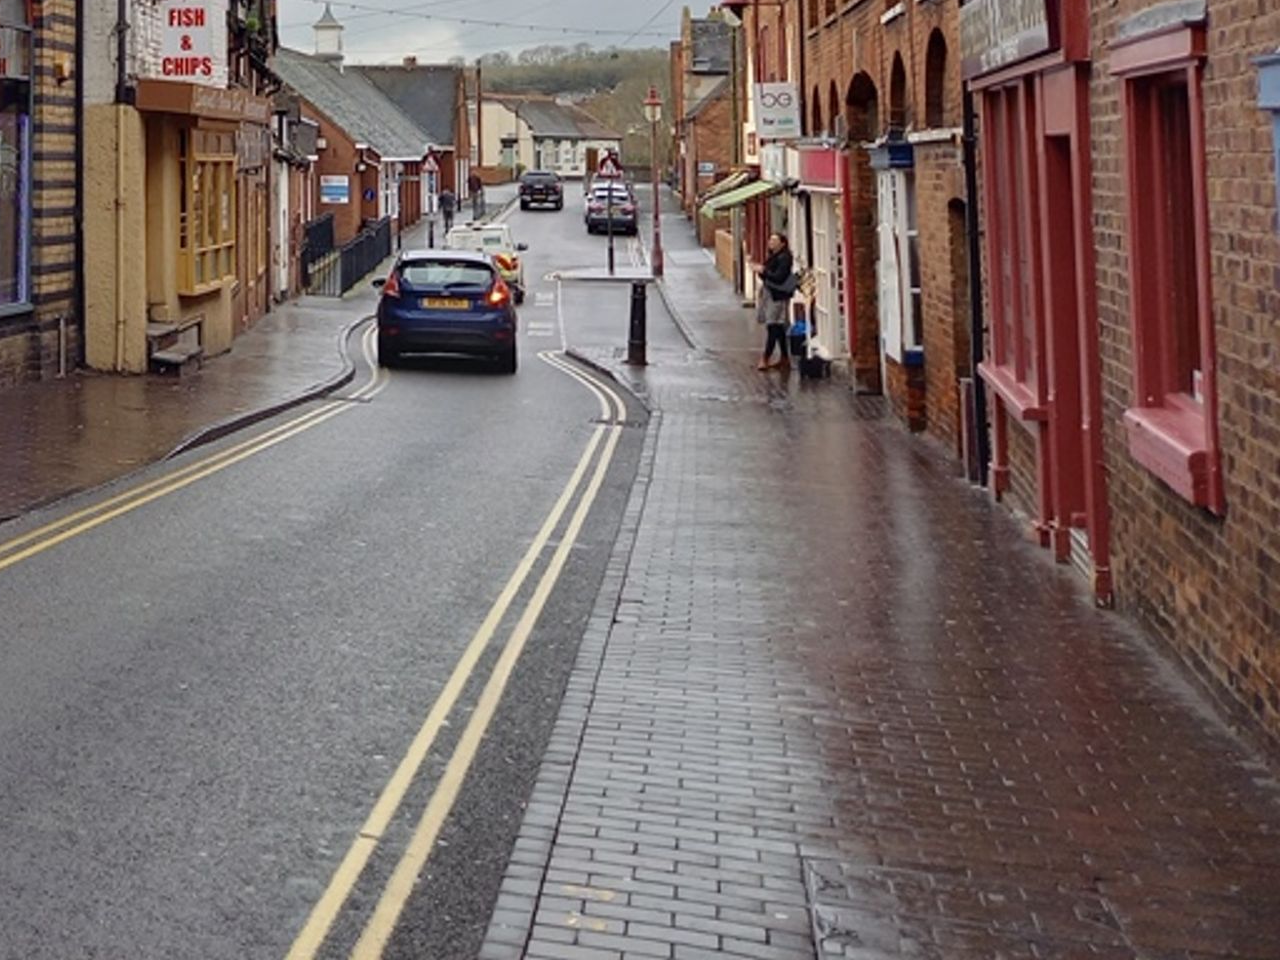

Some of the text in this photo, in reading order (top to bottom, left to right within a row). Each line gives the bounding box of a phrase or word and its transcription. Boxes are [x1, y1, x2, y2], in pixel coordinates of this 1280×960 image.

[169, 7, 205, 28] FISH
[181, 35, 192, 51] &
[162, 57, 212, 76] CHIPS
